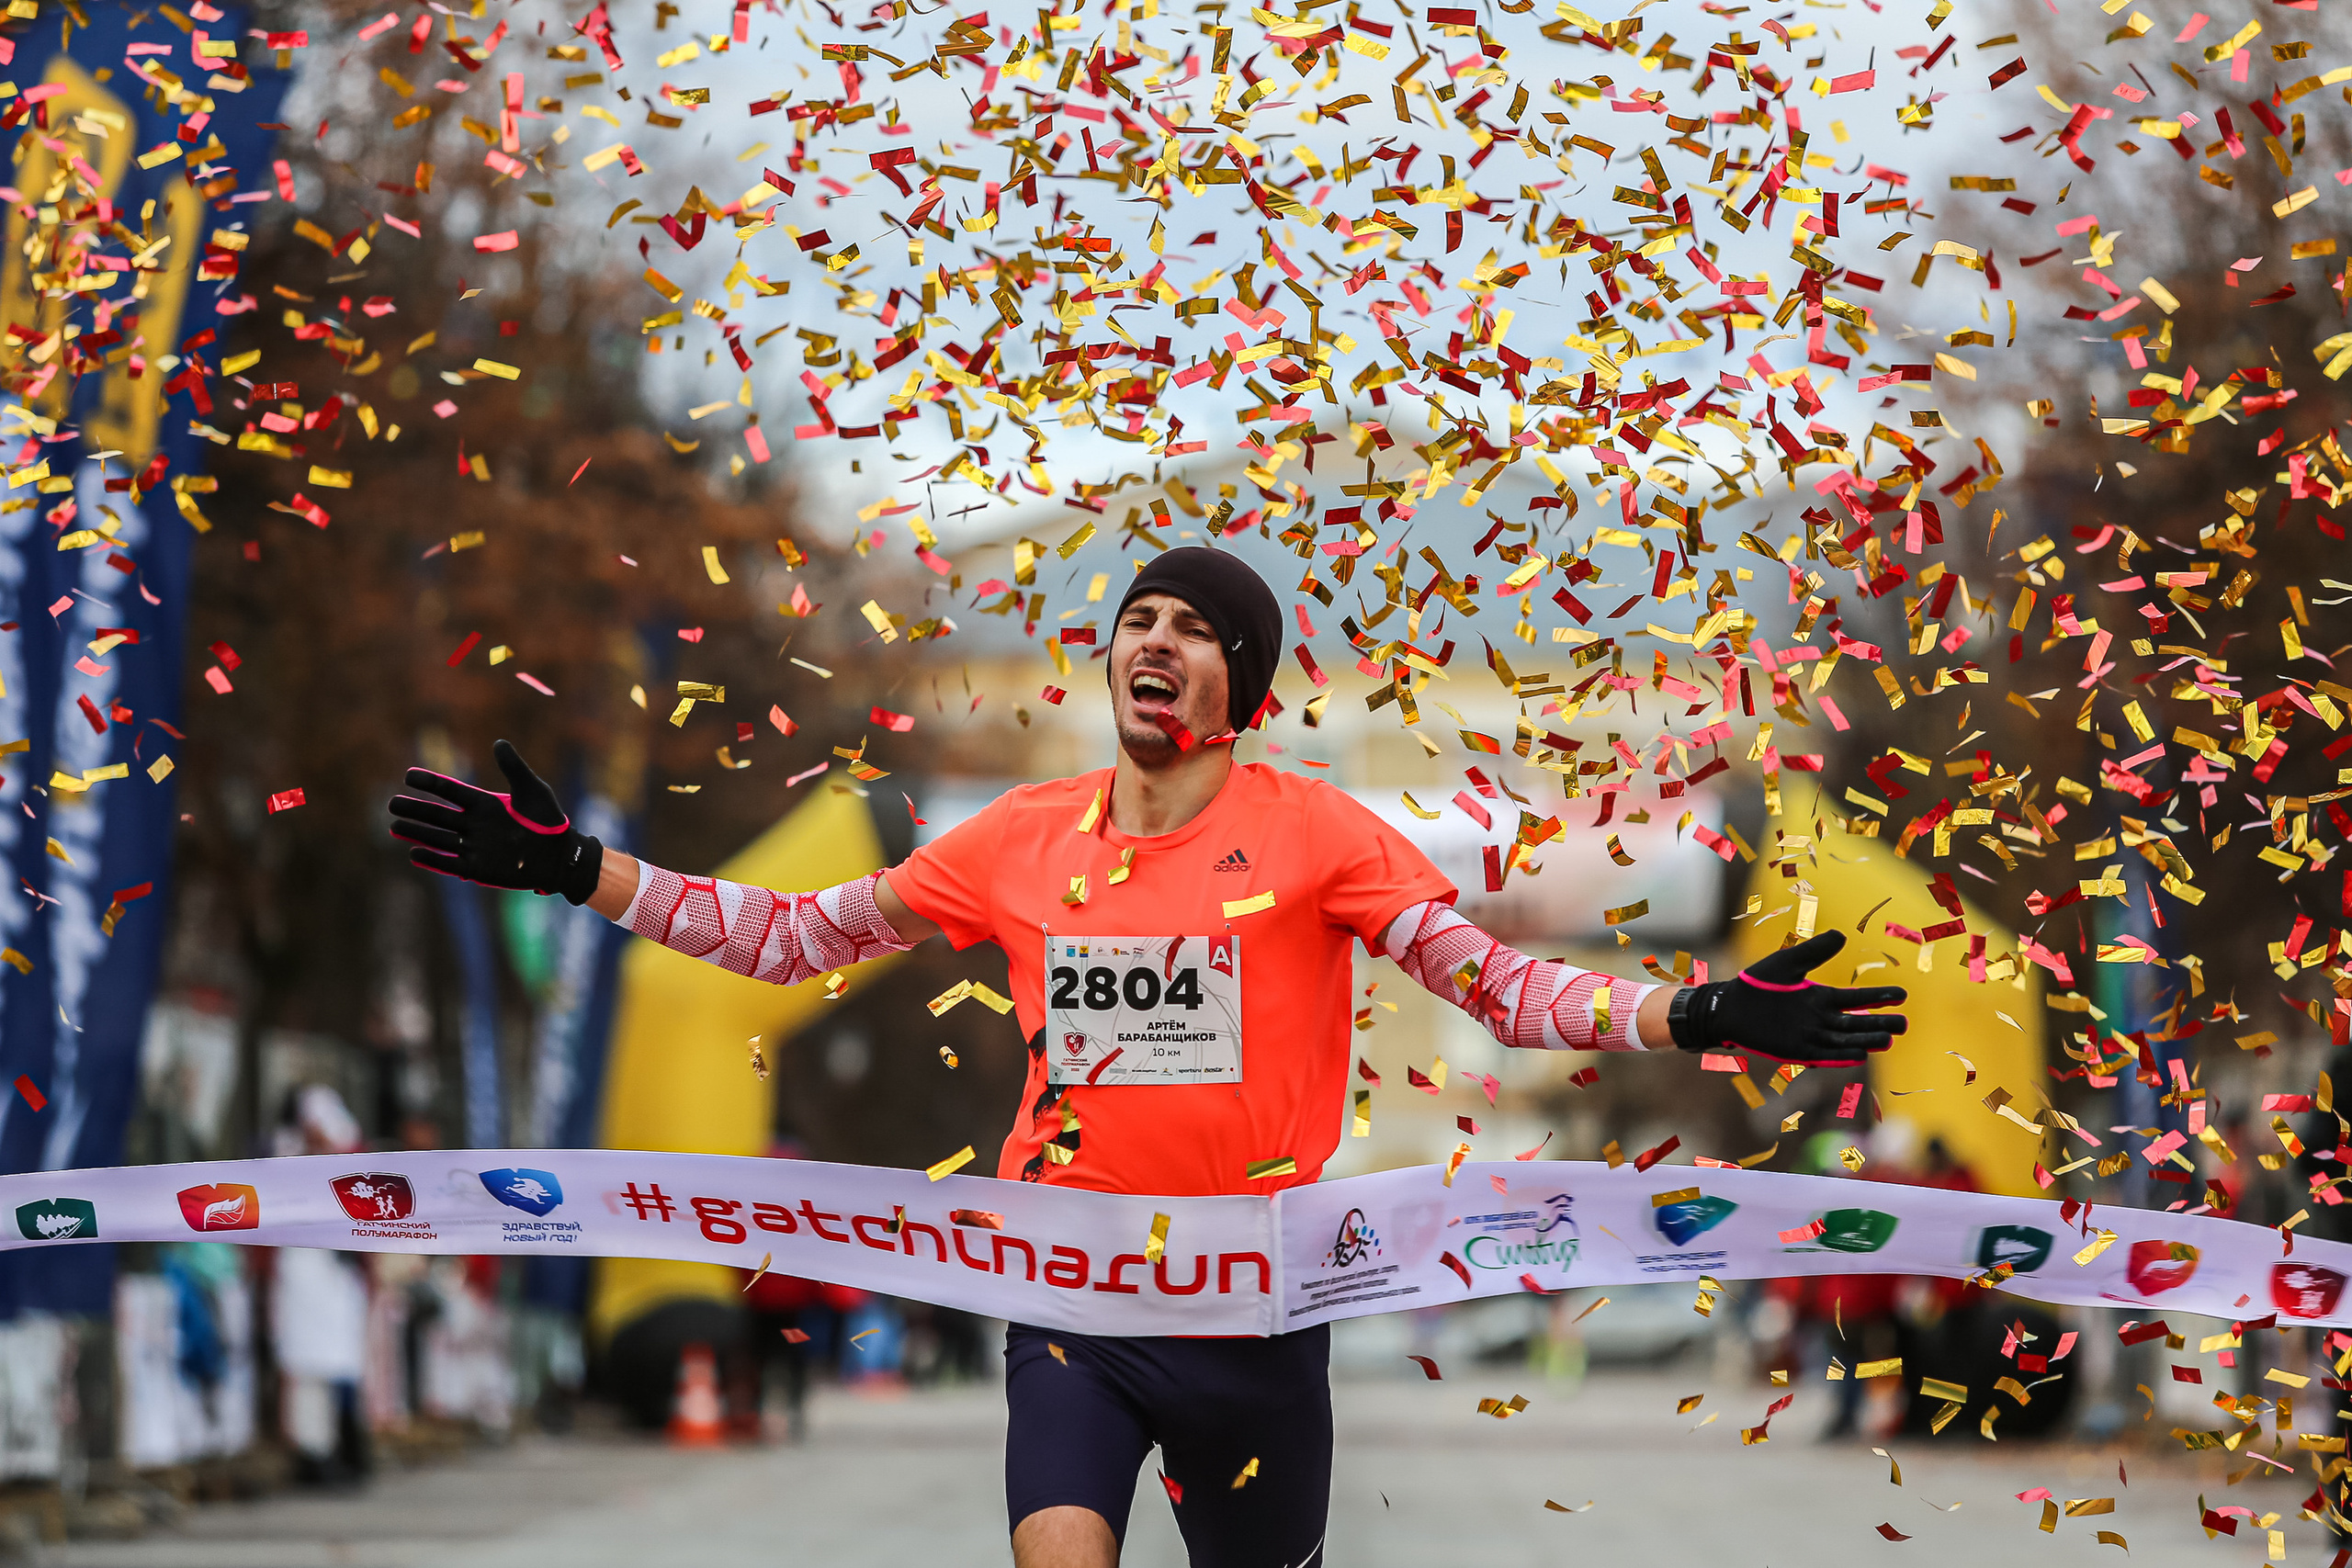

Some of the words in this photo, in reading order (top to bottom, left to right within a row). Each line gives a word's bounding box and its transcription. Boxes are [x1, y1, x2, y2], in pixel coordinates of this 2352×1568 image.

[1050, 966, 1204, 1011] 2804
[1147, 1020, 1186, 1031] АРТЁМ
[1117, 1032, 1216, 1043] БАРАБАНЩИКОВ
[1153, 1048, 1165, 1057] 10
[356, 1221, 431, 1230] ГАТЧИНСКИЙ
[502, 1221, 582, 1233] ЗДРАВСТВУЙ,
[351, 1228, 437, 1240] ПОЛУМАРАФОН
[503, 1232, 547, 1242] НОВЫЙ
[549, 1234, 578, 1243] ГОД!
[619, 1181, 1271, 1295] #gatchinarun
